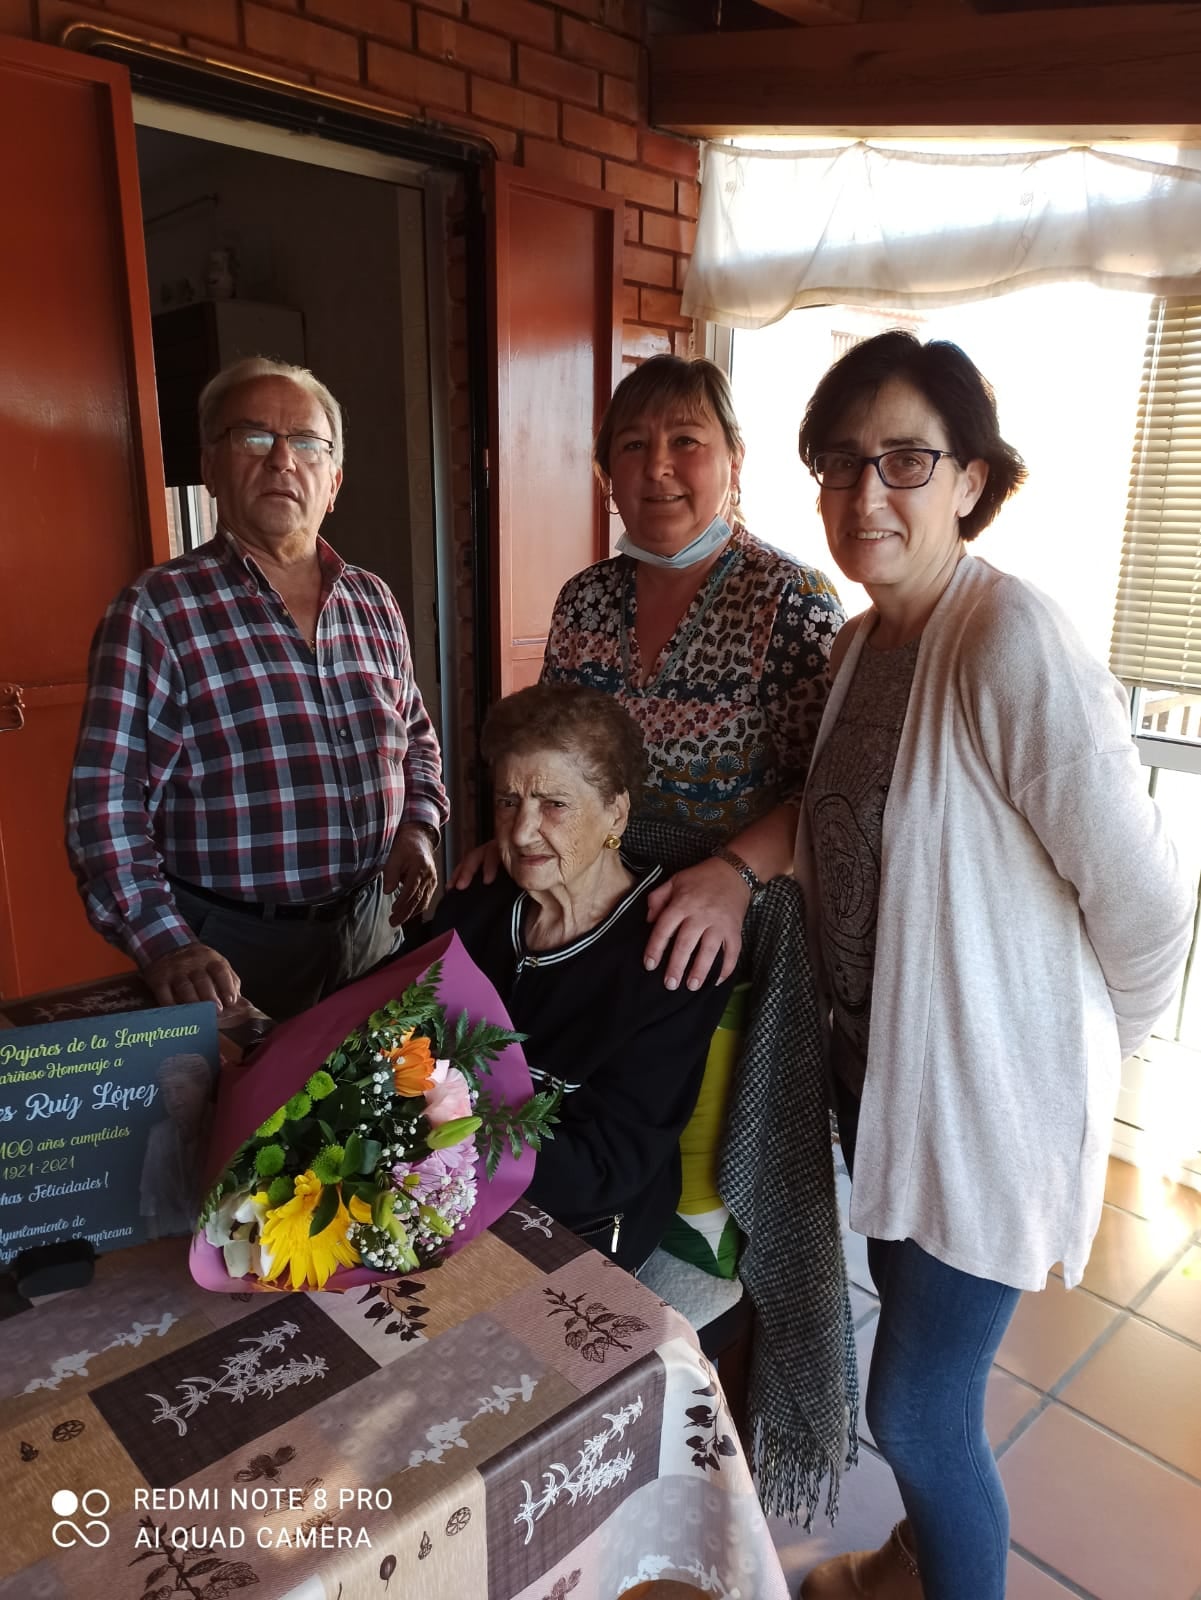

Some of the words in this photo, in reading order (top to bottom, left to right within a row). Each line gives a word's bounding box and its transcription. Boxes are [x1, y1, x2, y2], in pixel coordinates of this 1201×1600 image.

[0, 1043, 61, 1066] Pajares
[67, 1038, 86, 1053] de
[90, 1035, 109, 1048] la
[114, 1023, 200, 1048] Lampreana
[0, 1070, 45, 1085] ariñoso
[47, 1059, 111, 1079] Homenaje
[114, 1057, 124, 1067] a
[25, 1092, 82, 1121] Ruiz
[92, 1081, 159, 1111] López
[0, 1138, 33, 1160] 100
[37, 1139, 66, 1152] años
[70, 1126, 132, 1147] cumplidos
[2, 1156, 75, 1180] 1921-2021
[72, 1216, 86, 1228] de
